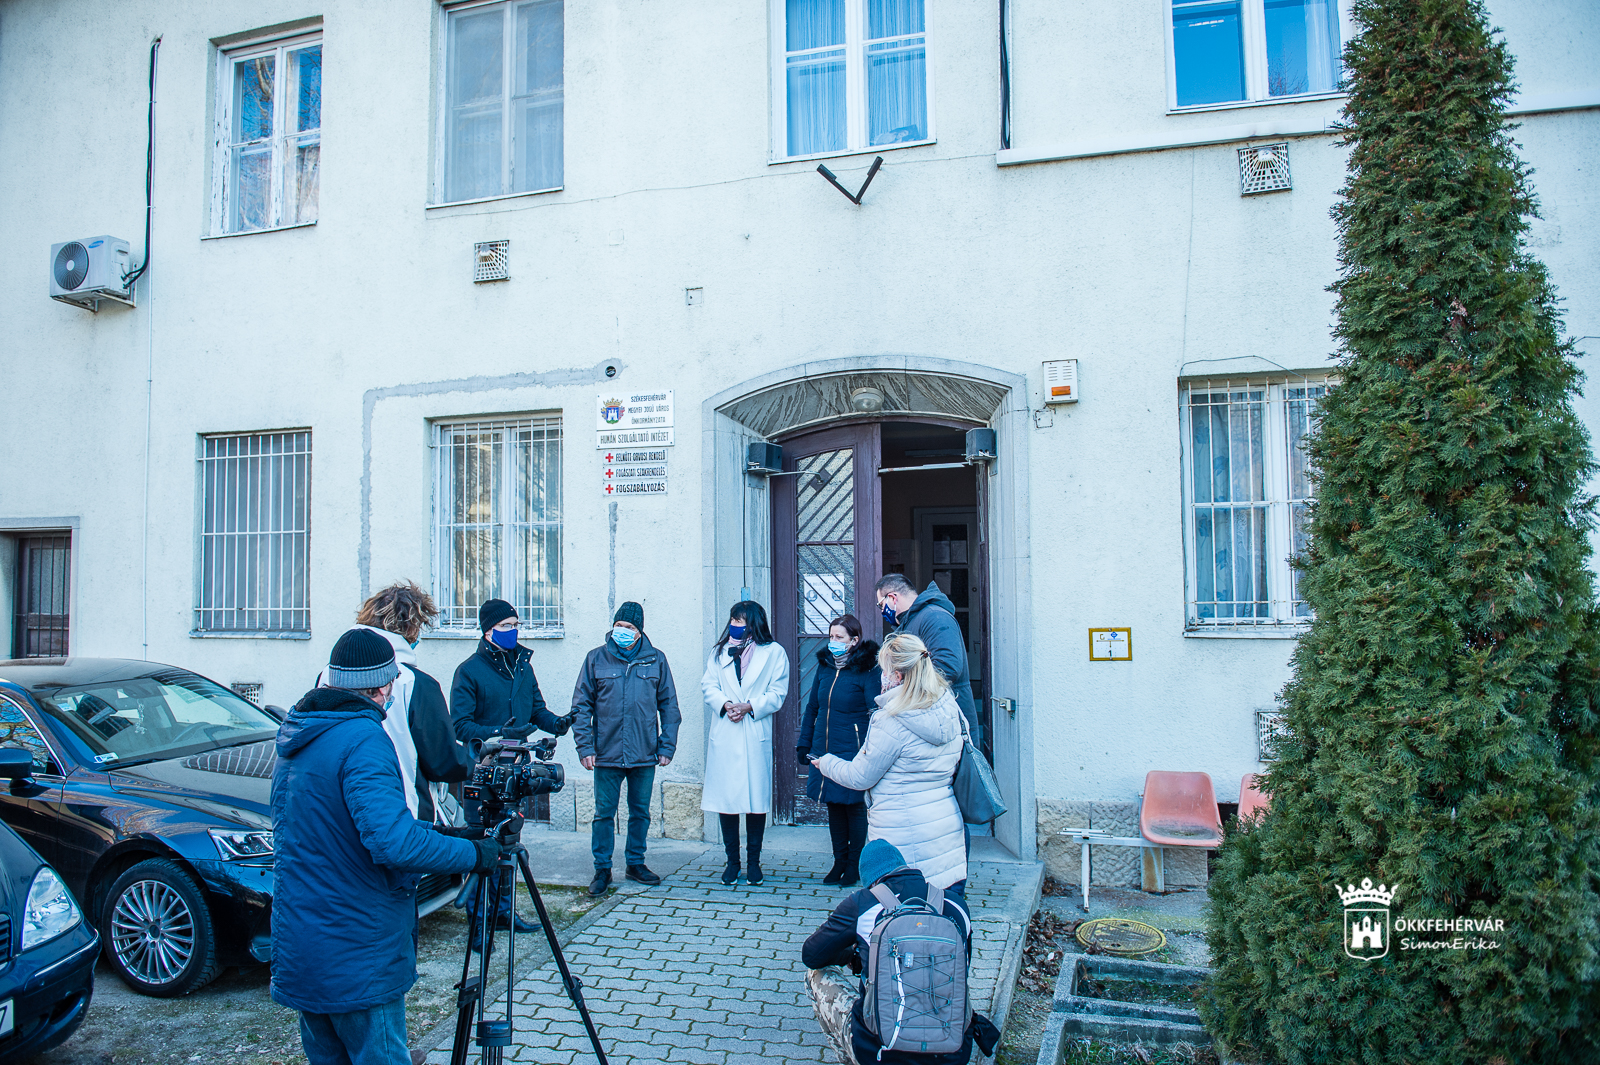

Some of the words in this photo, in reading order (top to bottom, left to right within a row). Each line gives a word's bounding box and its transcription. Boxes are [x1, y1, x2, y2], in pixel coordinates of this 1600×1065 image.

[630, 393, 667, 402] SZÉKESFEHÉRVÁR
[644, 404, 654, 413] JOGÚ
[656, 404, 669, 412] VÁROS
[631, 416, 666, 424] ÖNKORMÁNYZATA
[600, 433, 616, 444] HUMÁN
[618, 431, 649, 443] SZOLGÁLTATÓ
[651, 430, 669, 441] INTÉZET
[616, 481, 665, 493] FOGSZABÁLYOZÁS
